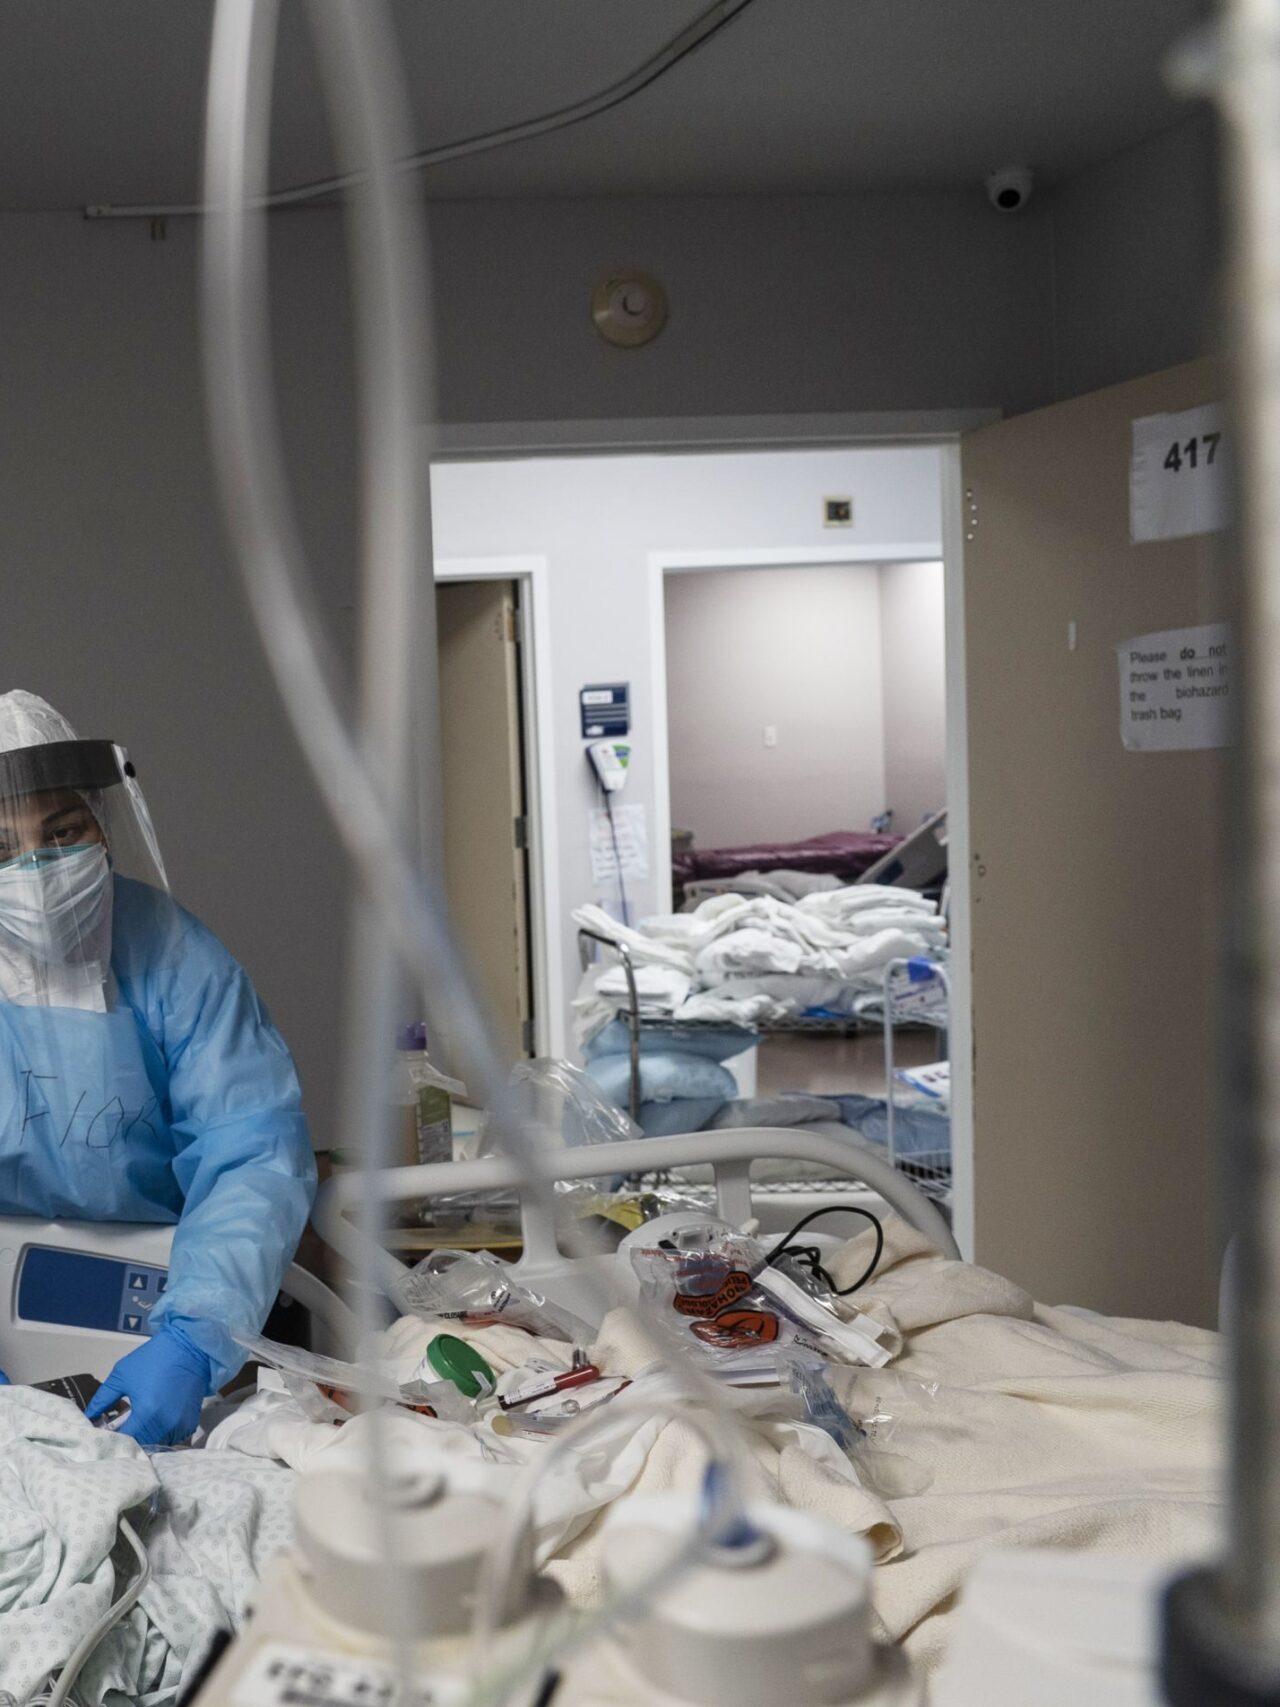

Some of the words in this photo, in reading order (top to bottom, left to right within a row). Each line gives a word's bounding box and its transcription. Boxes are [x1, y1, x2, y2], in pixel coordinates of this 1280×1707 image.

[1163, 432, 1221, 473] 417
[1130, 651, 1167, 664] Please
[1180, 646, 1196, 661] do
[1208, 643, 1228, 658] not
[1130, 671, 1158, 684] throw
[1163, 667, 1182, 681] the
[1187, 664, 1214, 678] linen
[1130, 708, 1158, 720] trash
[1160, 706, 1182, 722] bag
